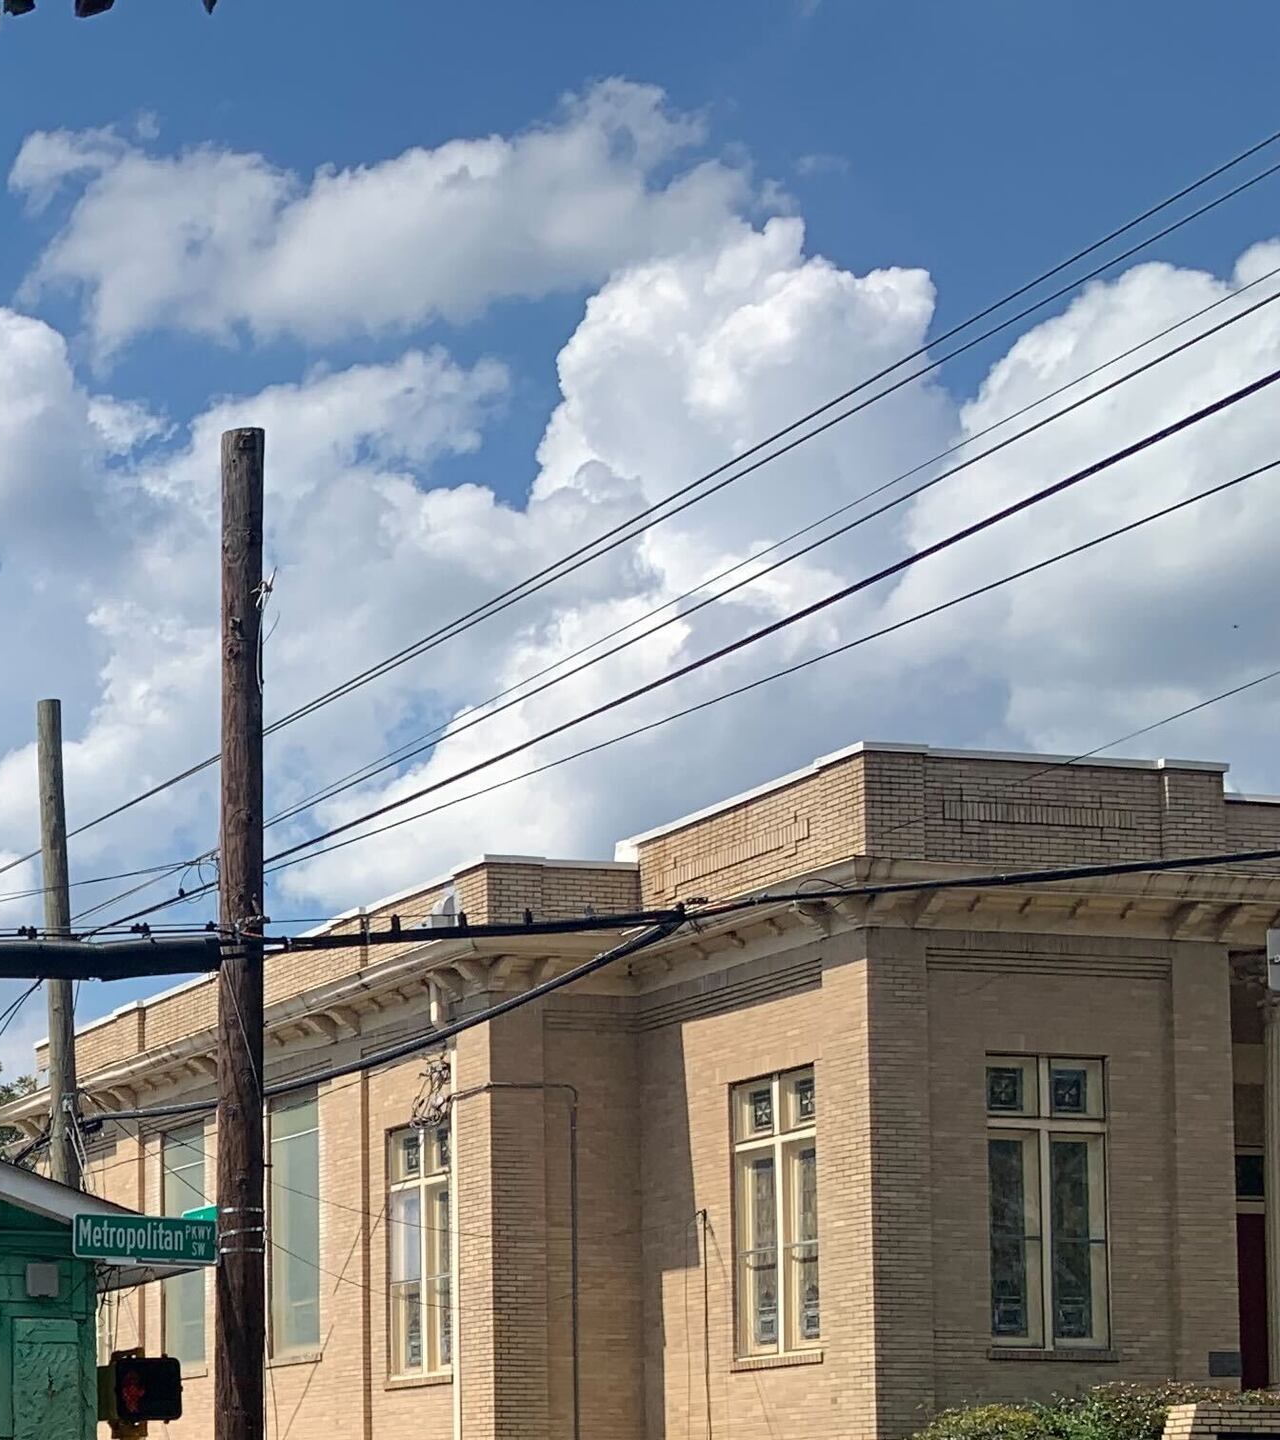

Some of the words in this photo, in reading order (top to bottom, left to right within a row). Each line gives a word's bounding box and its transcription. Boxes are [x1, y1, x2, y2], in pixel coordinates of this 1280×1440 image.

[78, 1218, 184, 1254] Metropolitan
[185, 1225, 212, 1241] PKWY
[191, 1242, 206, 1257] SW
